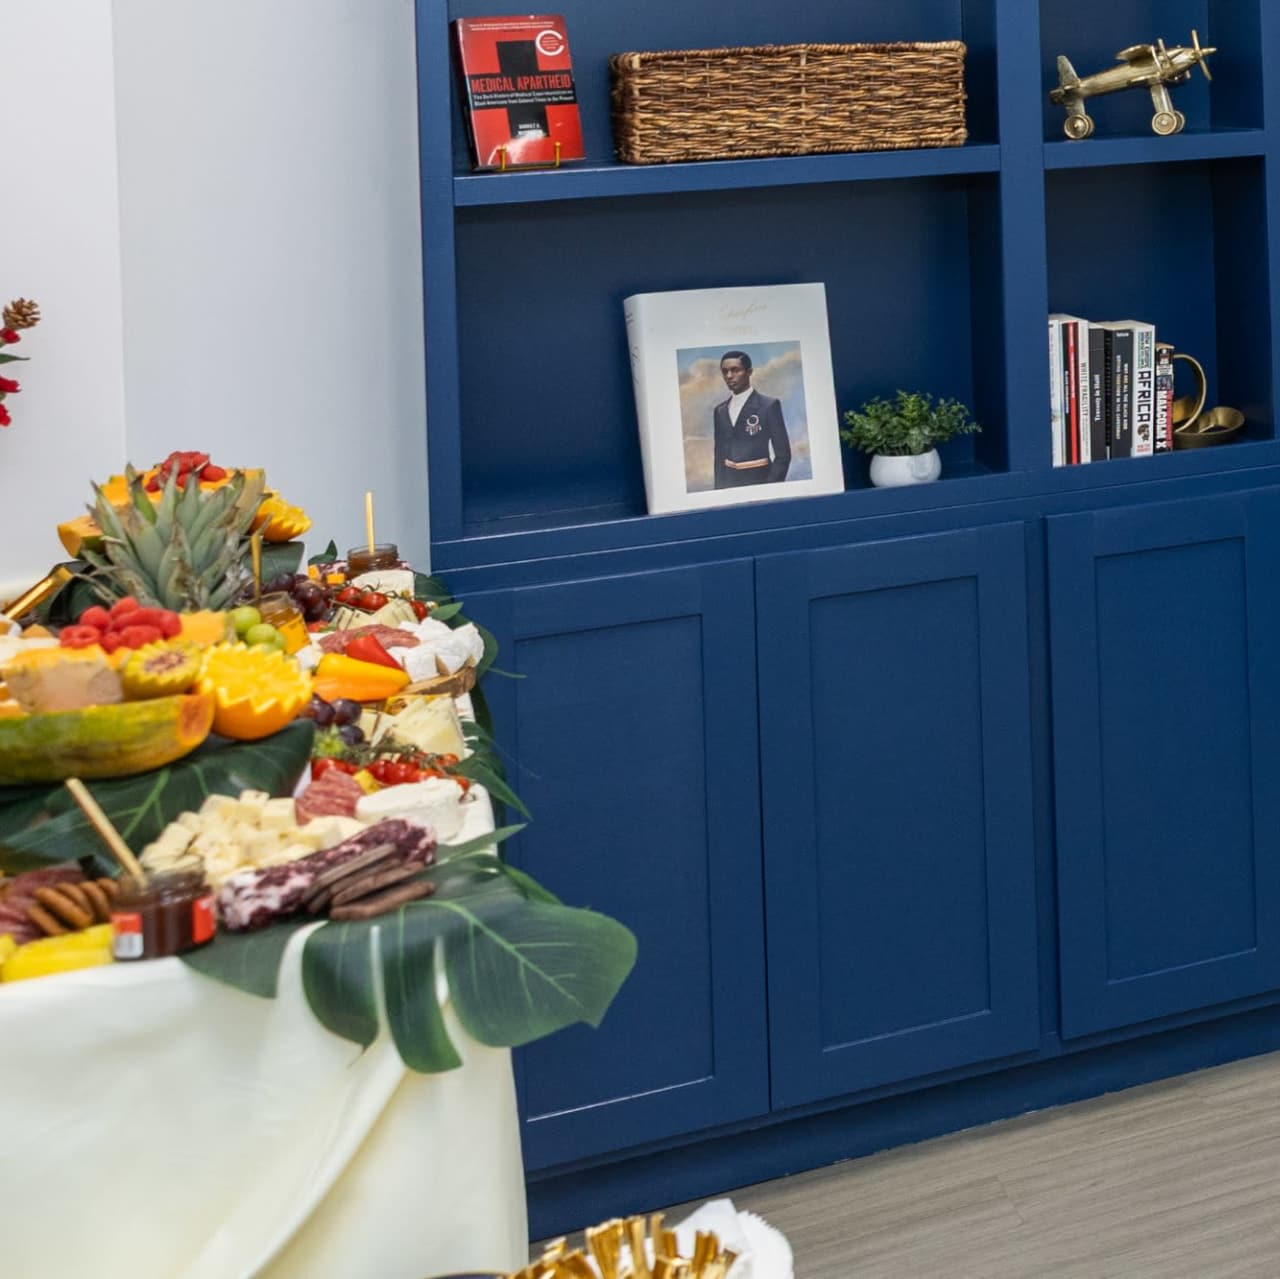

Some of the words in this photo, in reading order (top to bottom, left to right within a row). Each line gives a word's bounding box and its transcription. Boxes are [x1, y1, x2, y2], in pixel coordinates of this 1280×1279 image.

[470, 76, 515, 93] MEDICAL
[517, 74, 571, 90] APARTHEID
[1080, 362, 1088, 384] WHITE
[1081, 385, 1089, 416] FRAGILITY
[1137, 370, 1152, 422] AFRICA
[1156, 390, 1167, 439] MALCOLM
[1156, 440, 1167, 449] X
